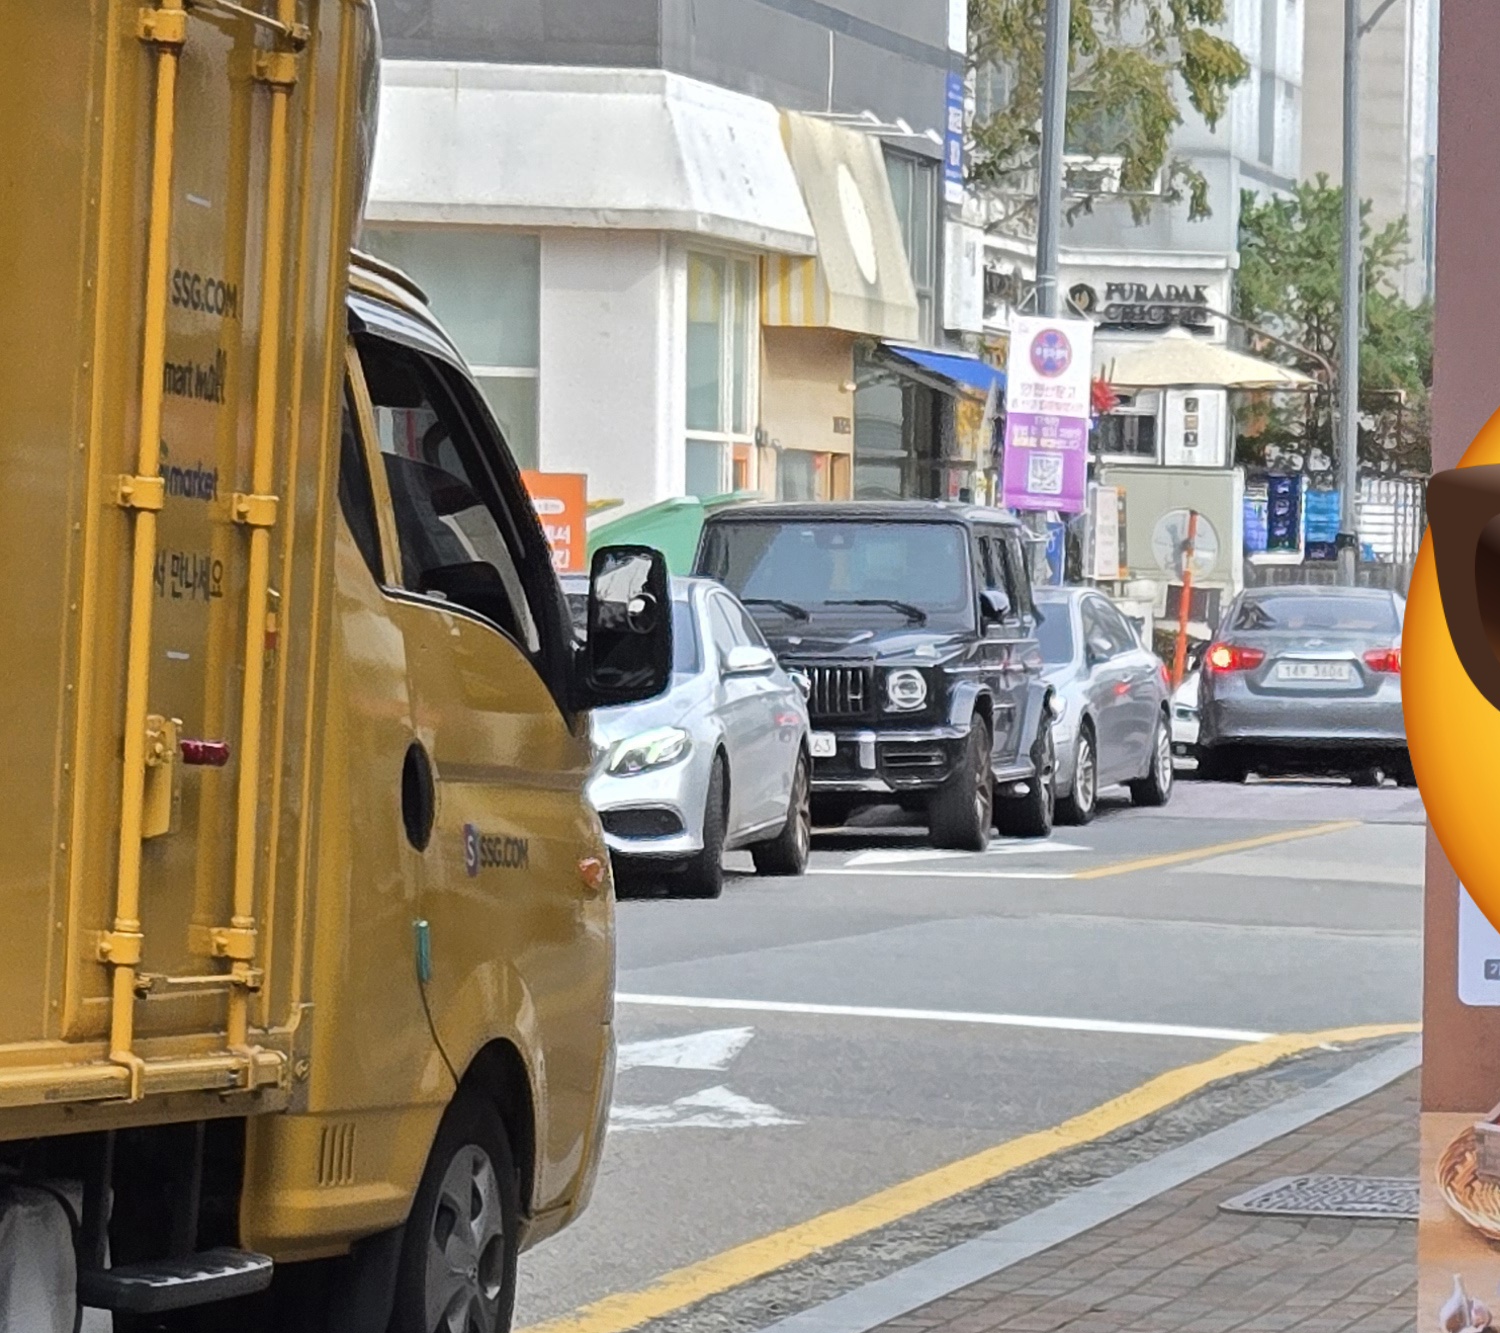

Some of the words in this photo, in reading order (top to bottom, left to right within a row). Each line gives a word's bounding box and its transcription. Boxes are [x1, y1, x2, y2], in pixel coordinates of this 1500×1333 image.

[172, 268, 238, 318] SSG.COM
[1105, 281, 1210, 303] PURADAK
[163, 359, 194, 399] mart
